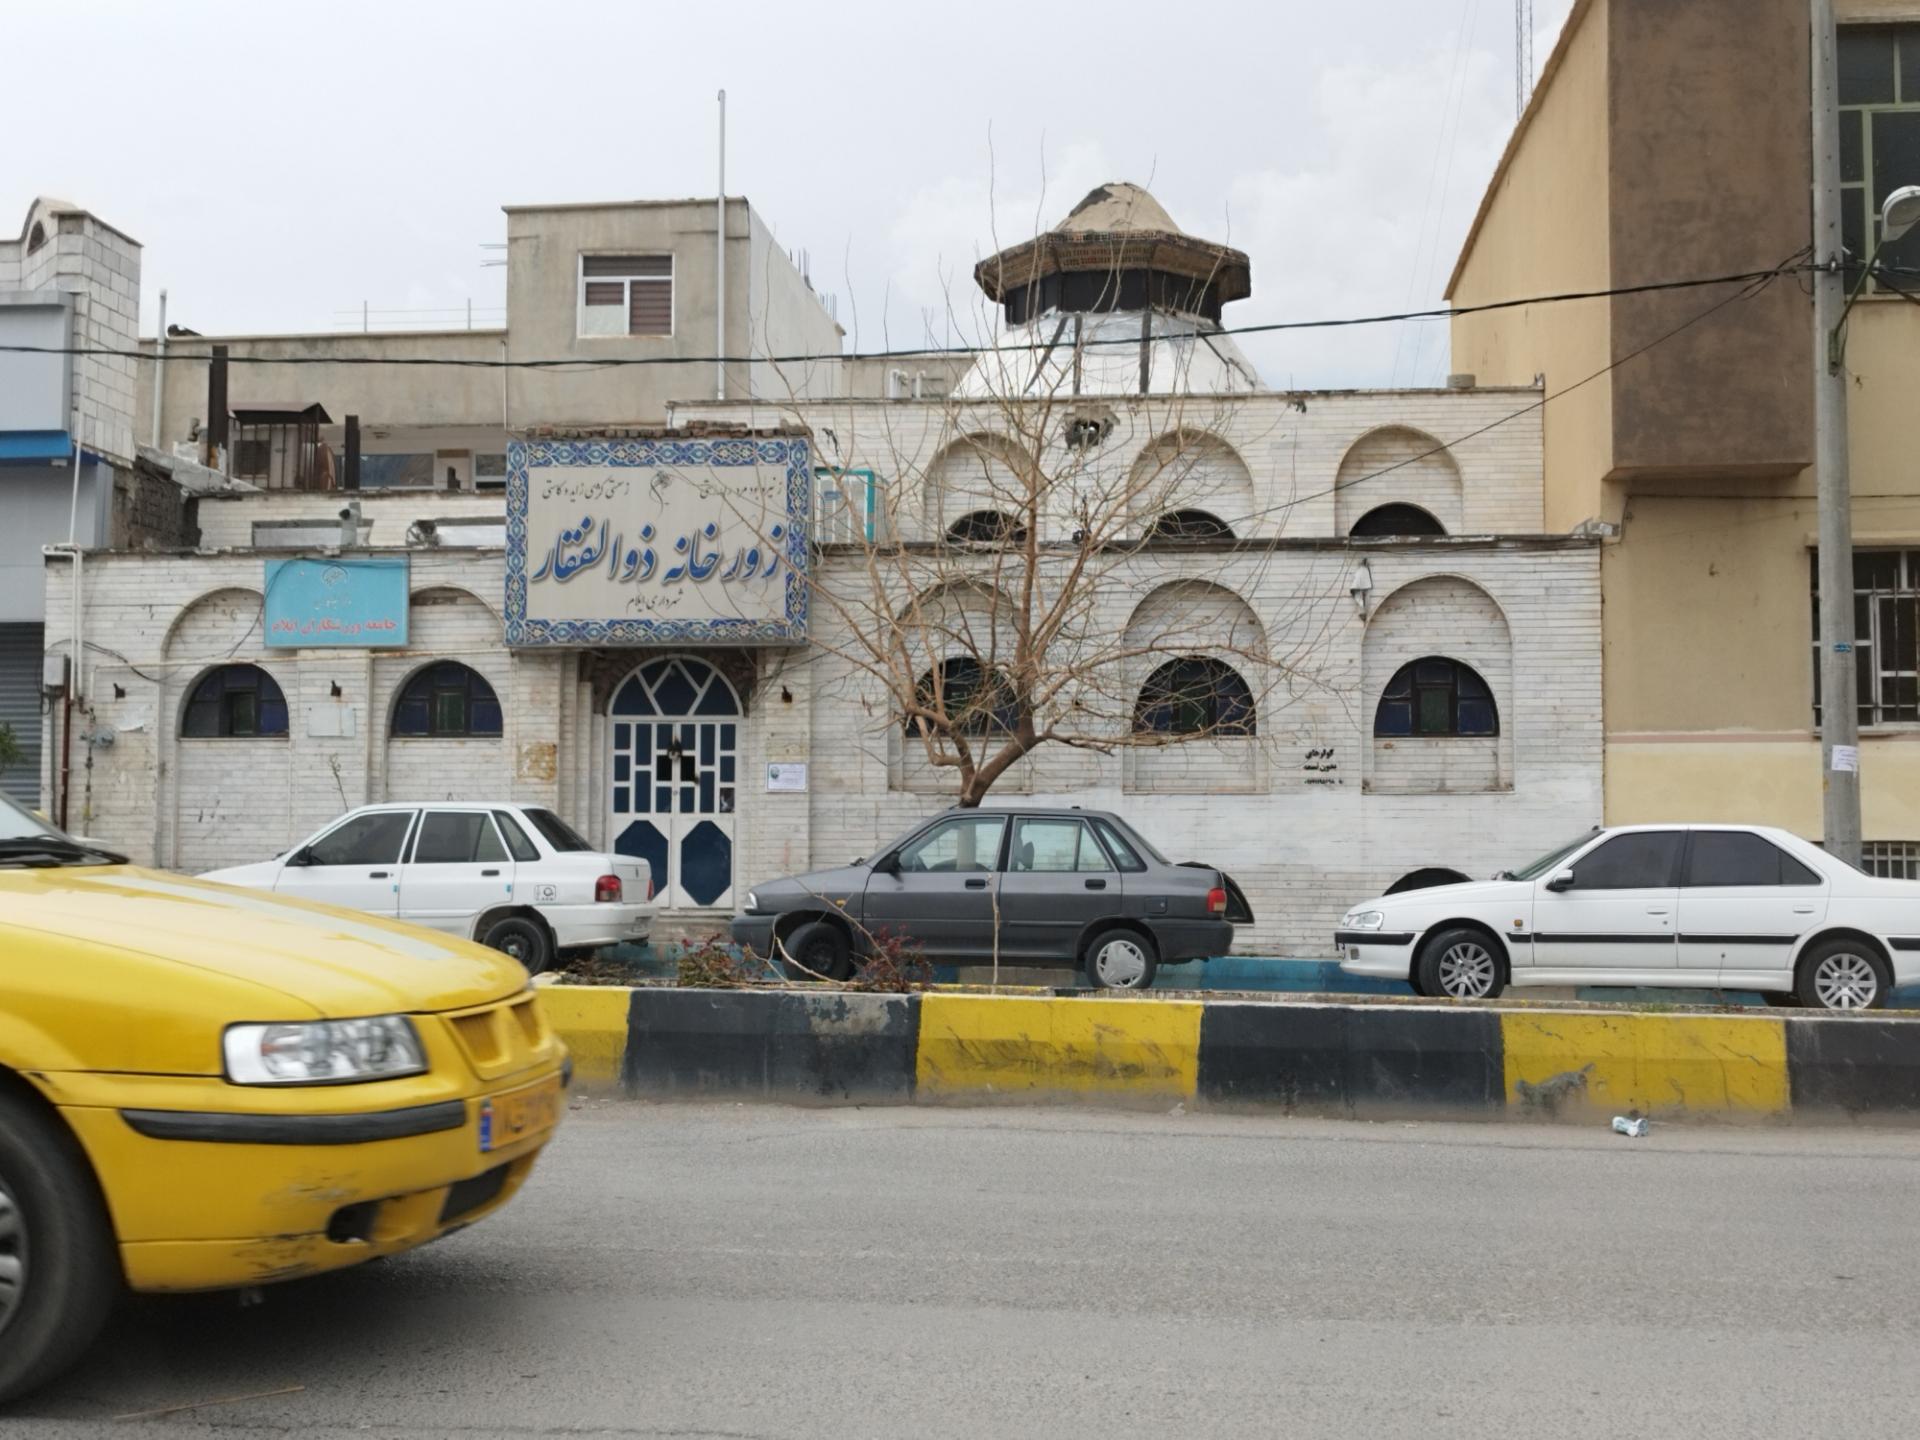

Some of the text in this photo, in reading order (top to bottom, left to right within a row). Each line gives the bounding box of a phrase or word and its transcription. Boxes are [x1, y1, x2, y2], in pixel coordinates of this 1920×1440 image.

[530, 515, 656, 583] ذوالفقار
[625, 588, 684, 615] شهرداری ایلام
[271, 617, 298, 633] ایلام
[365, 618, 397, 631] جامعه
